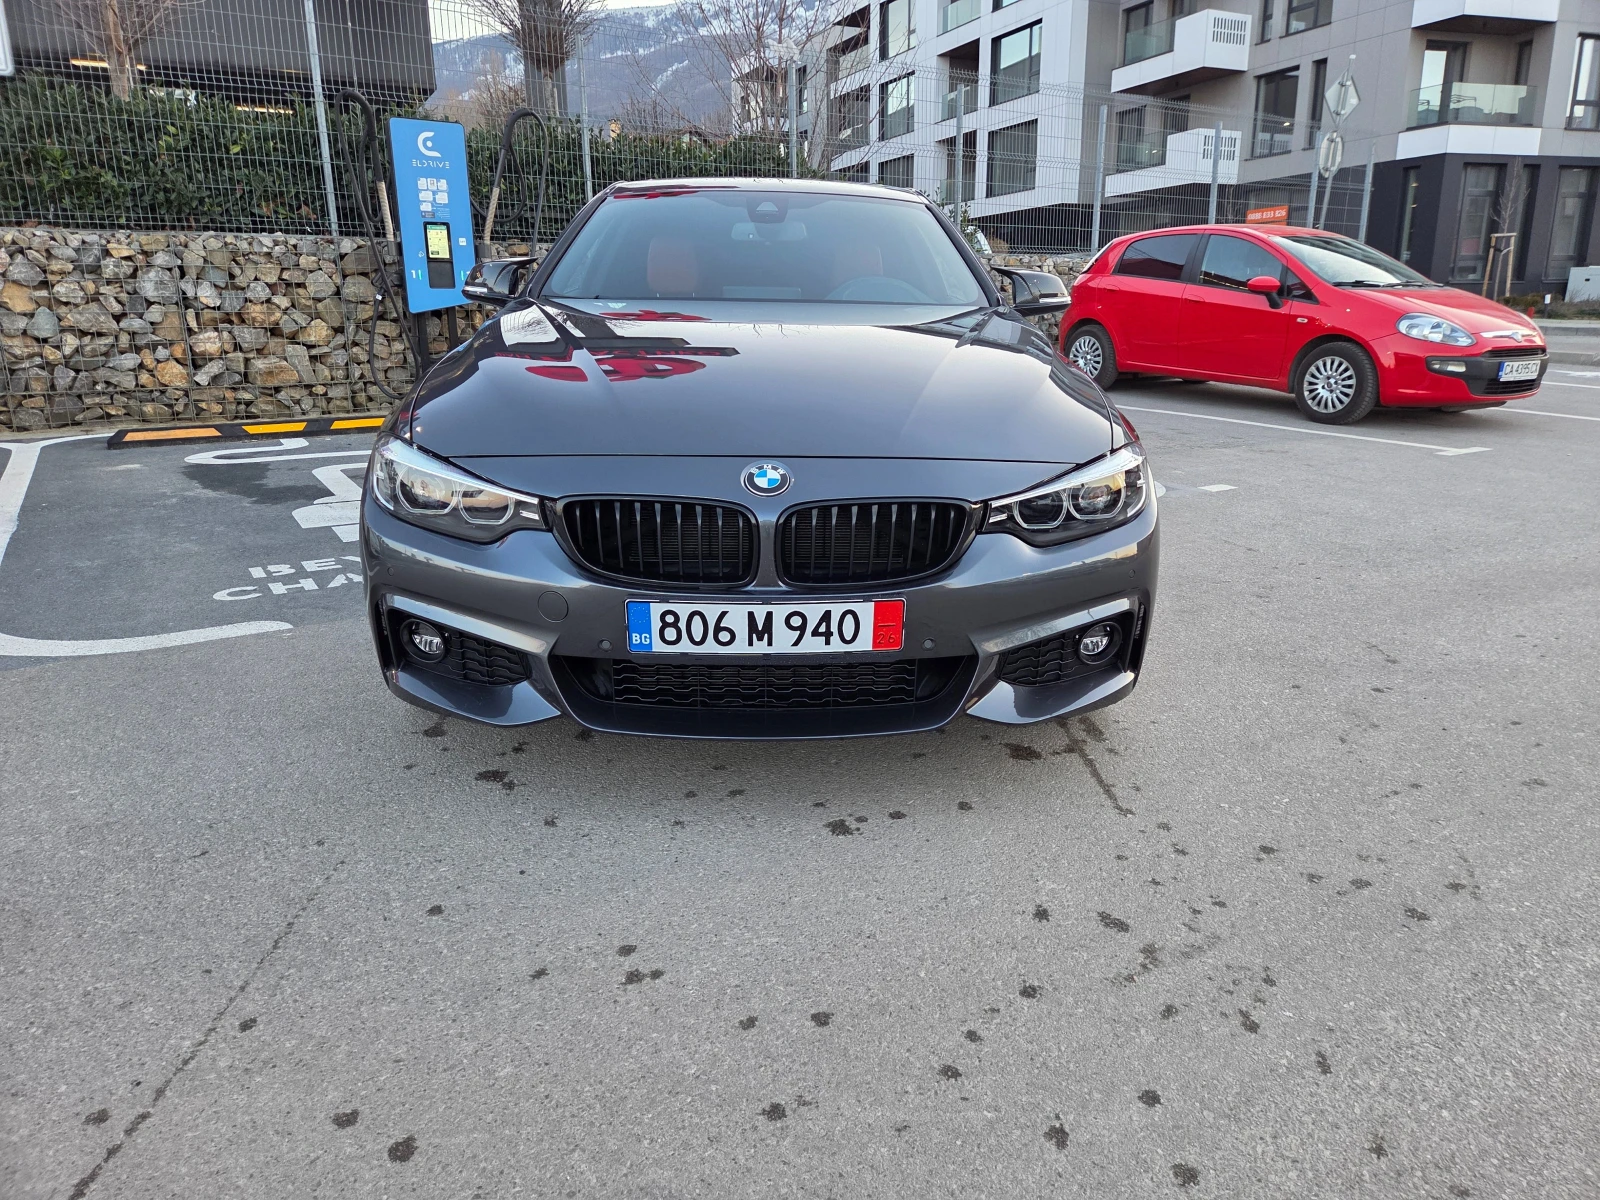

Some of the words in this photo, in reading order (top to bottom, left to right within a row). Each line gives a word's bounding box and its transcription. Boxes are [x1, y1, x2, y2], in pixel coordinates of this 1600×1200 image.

[412, 159, 449, 168] ELDRIVE
[1504, 364, 1514, 375] CA
[750, 463, 787, 475] BMW
[658, 609, 737, 647] 806
[747, 610, 773, 647] M
[784, 608, 861, 647] 940
[632, 633, 650, 645] BG
[877, 631, 897, 645] 26
